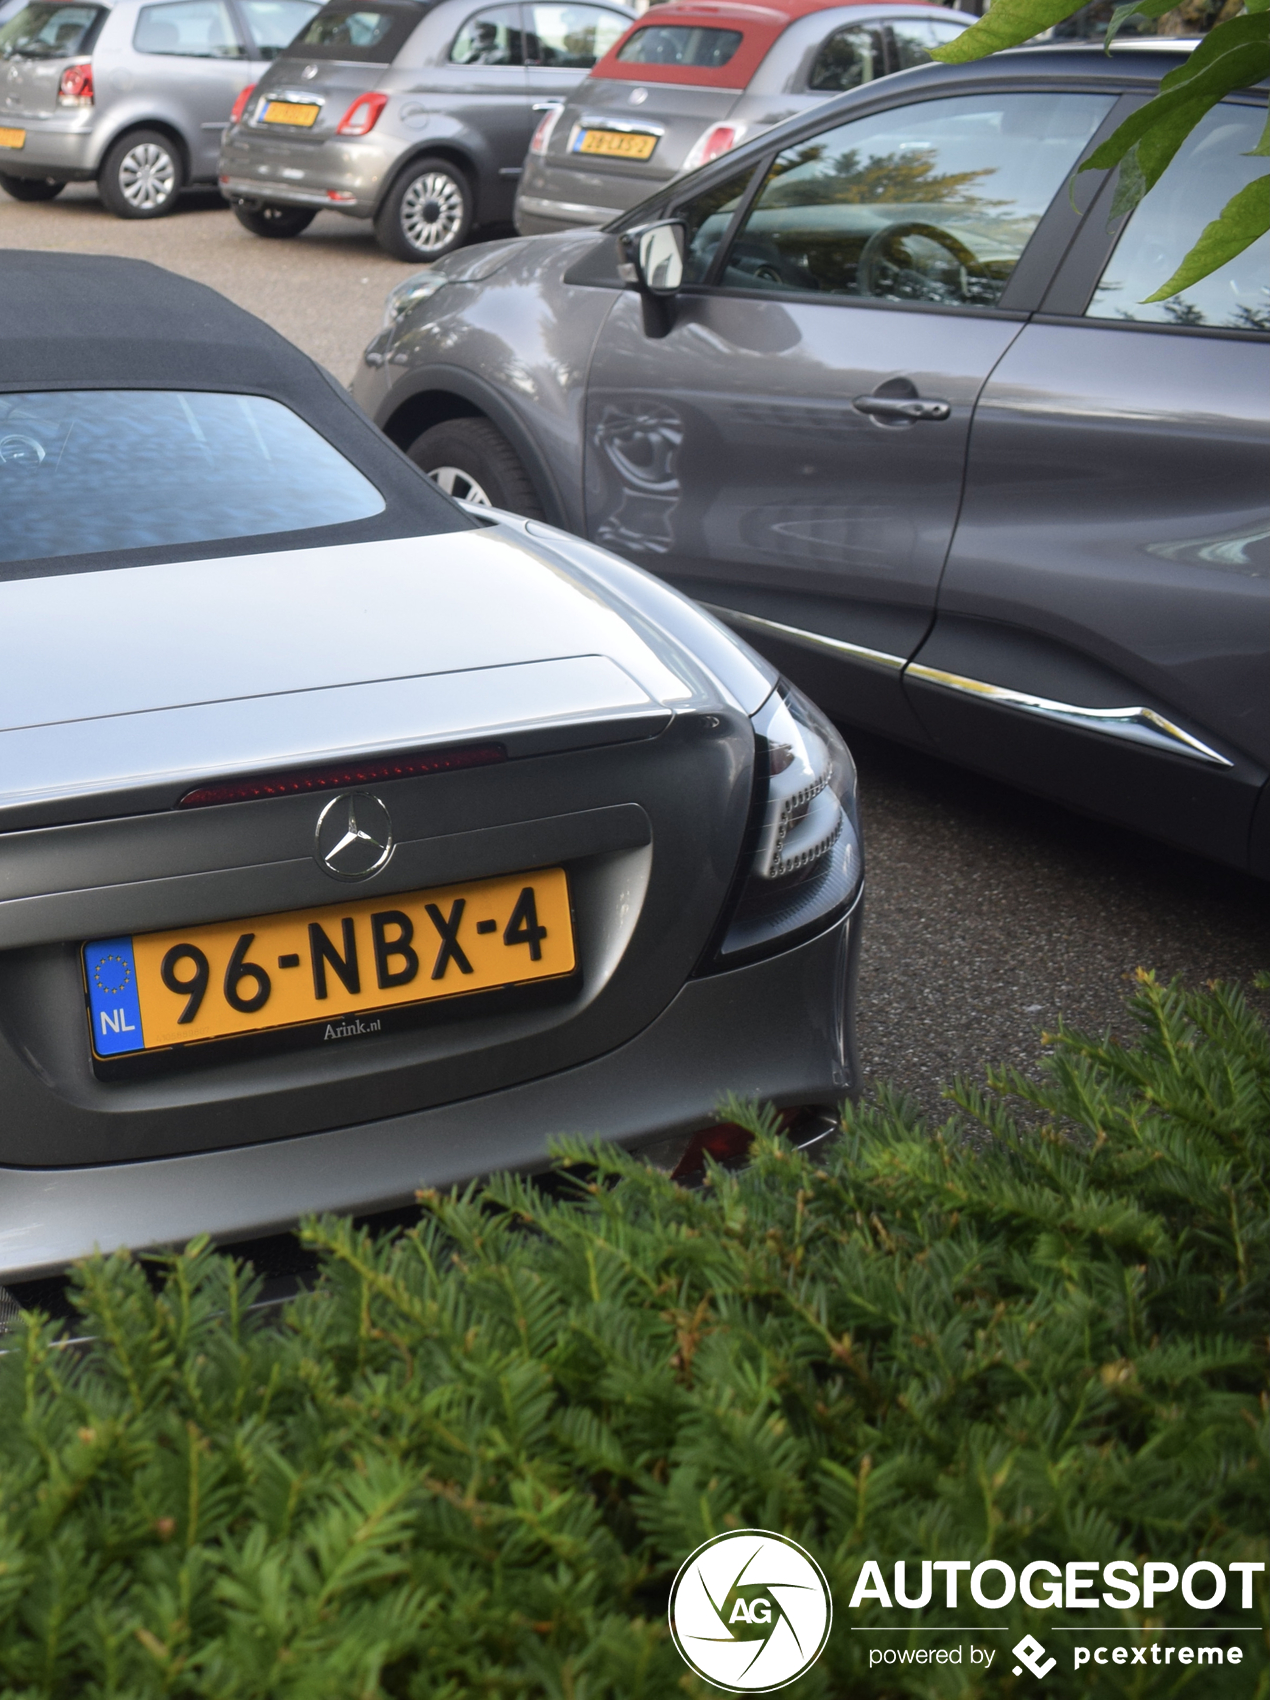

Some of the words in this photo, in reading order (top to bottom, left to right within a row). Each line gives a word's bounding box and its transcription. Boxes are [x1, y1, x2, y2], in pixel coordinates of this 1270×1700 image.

[160, 886, 548, 1025] 96-NBX-4
[99, 1007, 136, 1036] NL
[323, 1019, 382, 1041] Arink.nl
